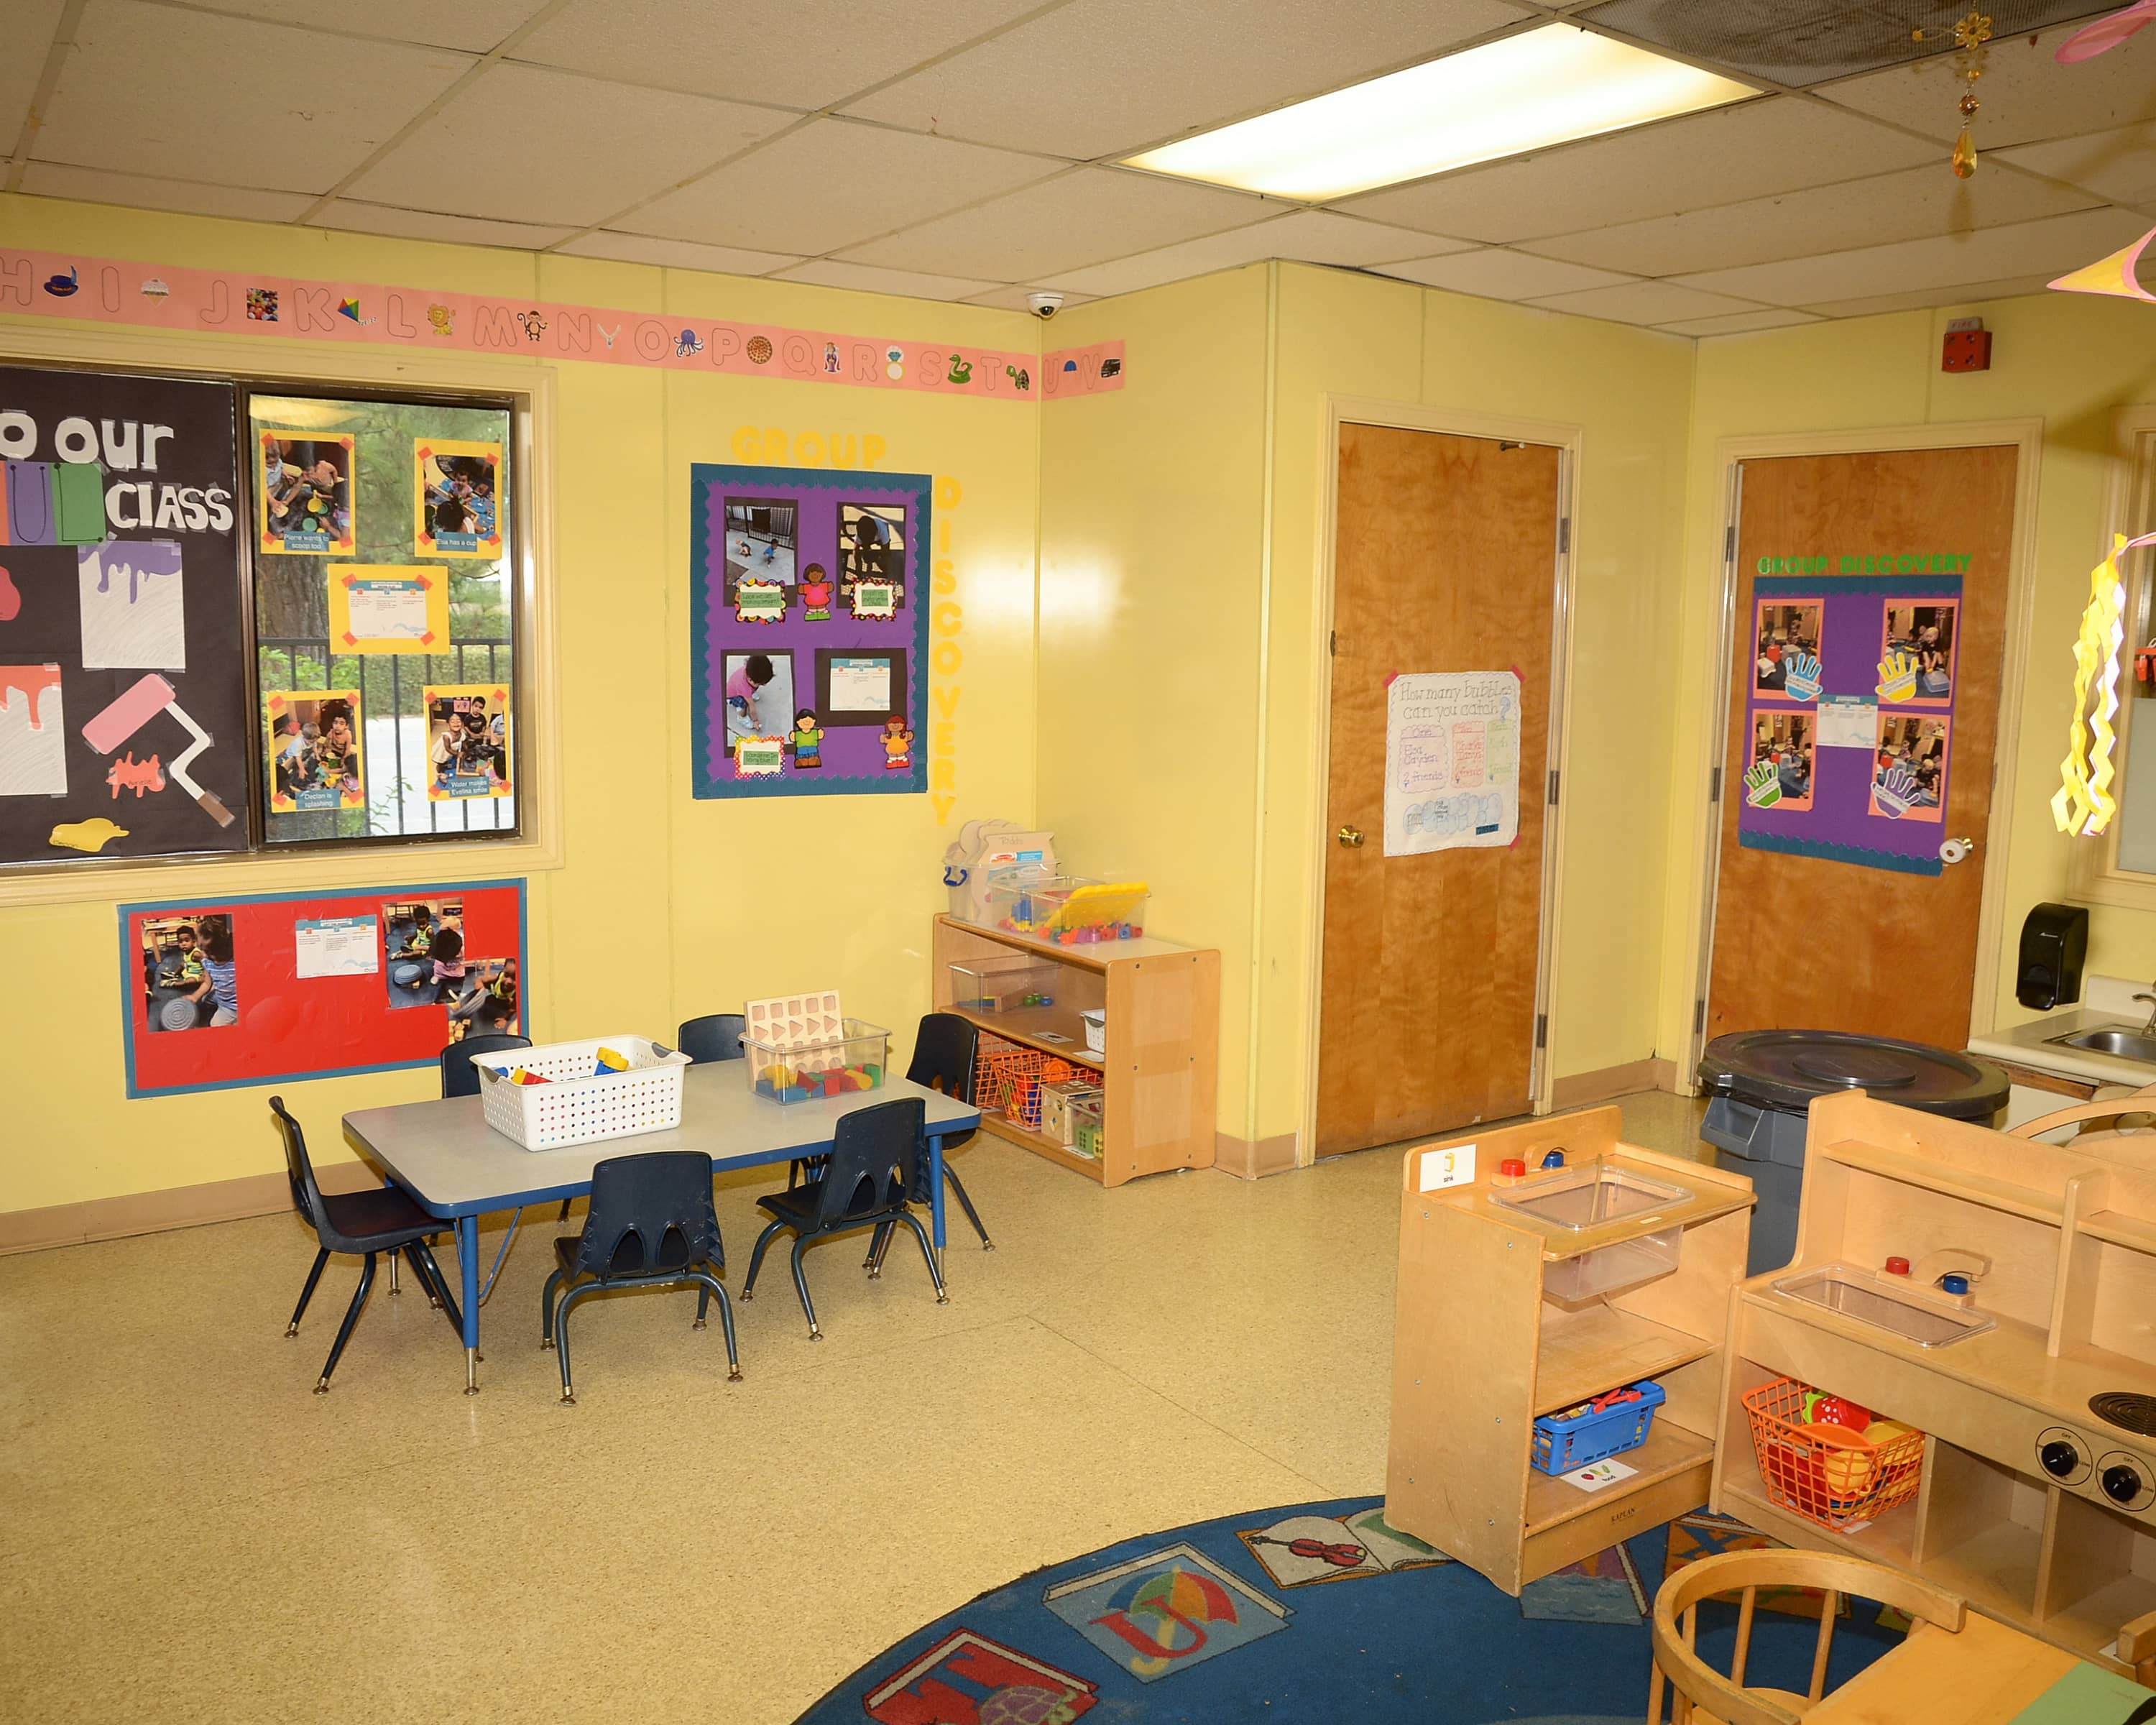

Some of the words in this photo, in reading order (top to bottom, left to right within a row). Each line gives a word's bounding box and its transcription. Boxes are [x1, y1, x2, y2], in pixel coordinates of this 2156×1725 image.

[101, 266, 120, 313] I
[200, 280, 229, 323] J
[293, 288, 335, 332] K
[387, 294, 417, 339] L
[473, 305, 517, 347] M
[557, 311, 591, 352] N
[634, 320, 670, 362] O
[711, 328, 740, 366] P
[783, 335, 816, 376] Q
[852, 344, 877, 382] R
[918, 351, 942, 386] S
[980, 356, 1002, 391] T
[1042, 358, 1059, 393] U
[1080, 353, 1099, 390] V
[55, 418, 174, 469] our
[732, 426, 886, 469] GROUP
[1757, 556, 1828, 574] GROUP
[1840, 553, 1973, 574] DISCOVERY
[931, 475, 962, 826] DISCOVERY
[1401, 682, 1426, 701] How
[1427, 688, 1460, 702] many
[1403, 707, 1433, 719] can
[1434, 704, 1457, 722] you
[1443, 1174, 1454, 1183] sink
[1611, 1508, 1635, 1522] KAPLAN
[1089, 1596, 1209, 1658] U
